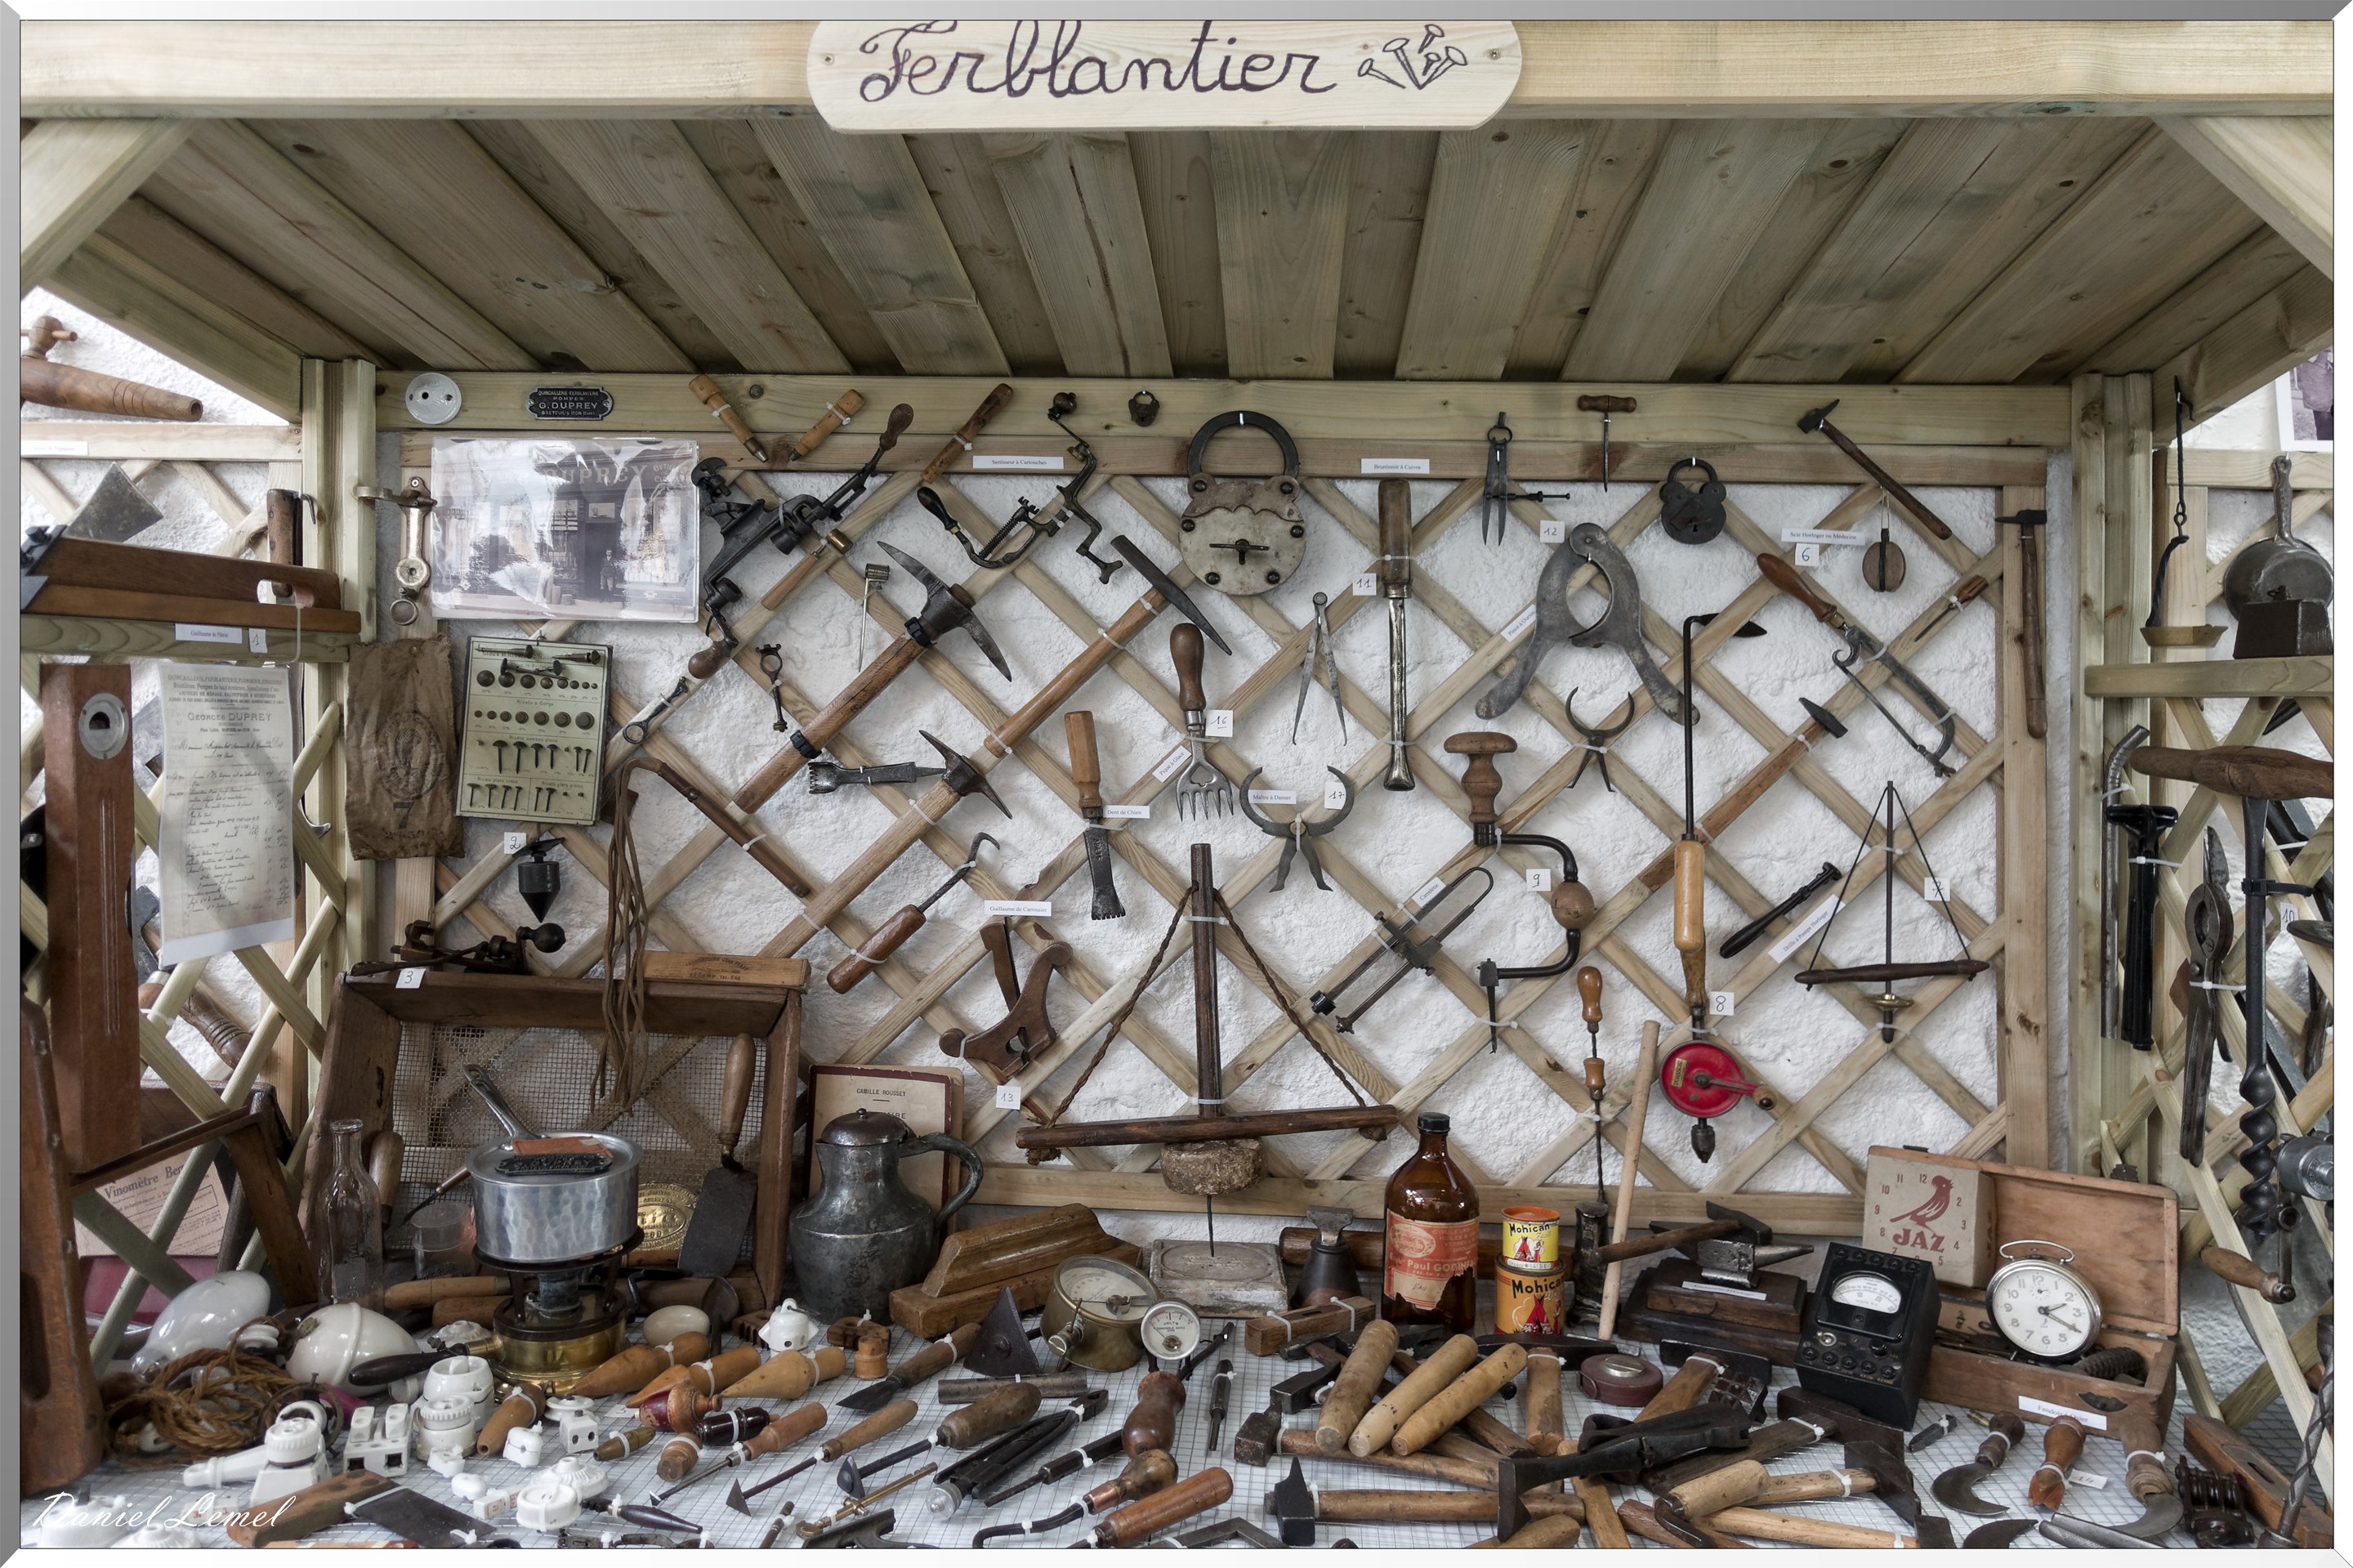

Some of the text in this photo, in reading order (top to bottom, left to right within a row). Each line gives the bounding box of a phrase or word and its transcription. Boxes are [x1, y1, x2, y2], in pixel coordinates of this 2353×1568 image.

[859, 20, 1338, 102] Ferblantier
[1543, 527, 1558, 537] 12
[1802, 547, 1811, 562] 6
[1355, 579, 1373, 588] 11
[252, 633, 260, 646] 1
[188, 712, 271, 721] GEORGES DUPREY
[1328, 791, 1345, 800] 17
[393, 802, 415, 829] 7
[509, 836, 521, 851] 2
[2282, 909, 2295, 923] 10
[404, 970, 413, 984] 3
[1716, 995, 1726, 1012] 8
[1000, 1092, 1014, 1102] 13
[1896, 1173, 1904, 1183] 11
[1920, 1173, 1928, 1184] 12
[104, 1176, 159, 1199] Vinomètre
[1882, 1185, 1890, 1195] 10
[1956, 1197, 1962, 1207] 2
[1874, 1204, 1880, 1214] 9
[1509, 1223, 1551, 1236] Mohican
[1961, 1220, 1967, 1230] 3
[1880, 1227, 1885, 1237] 8
[1892, 1227, 1945, 1253] JAZ
[1953, 1240, 1960, 1250] 4
[1407, 1259, 1431, 1271] Paul
[1938, 1255, 1944, 1266] 5
[2018, 1279, 2025, 1289] 11
[2033, 1275, 2044, 1284] 12
[2054, 1280, 2059, 1290] 1
[2007, 1289, 2019, 1298] 10
[2065, 1292, 2074, 1302] 2
[2003, 1303, 2012, 1312] 9
[2073, 1308, 2082, 1317] 3
[2011, 1318, 2020, 1328] 8
[2025, 1329, 2034, 1339] 7
[2059, 1333, 2067, 1342] 5
[2042, 1335, 2051, 1345] 6
